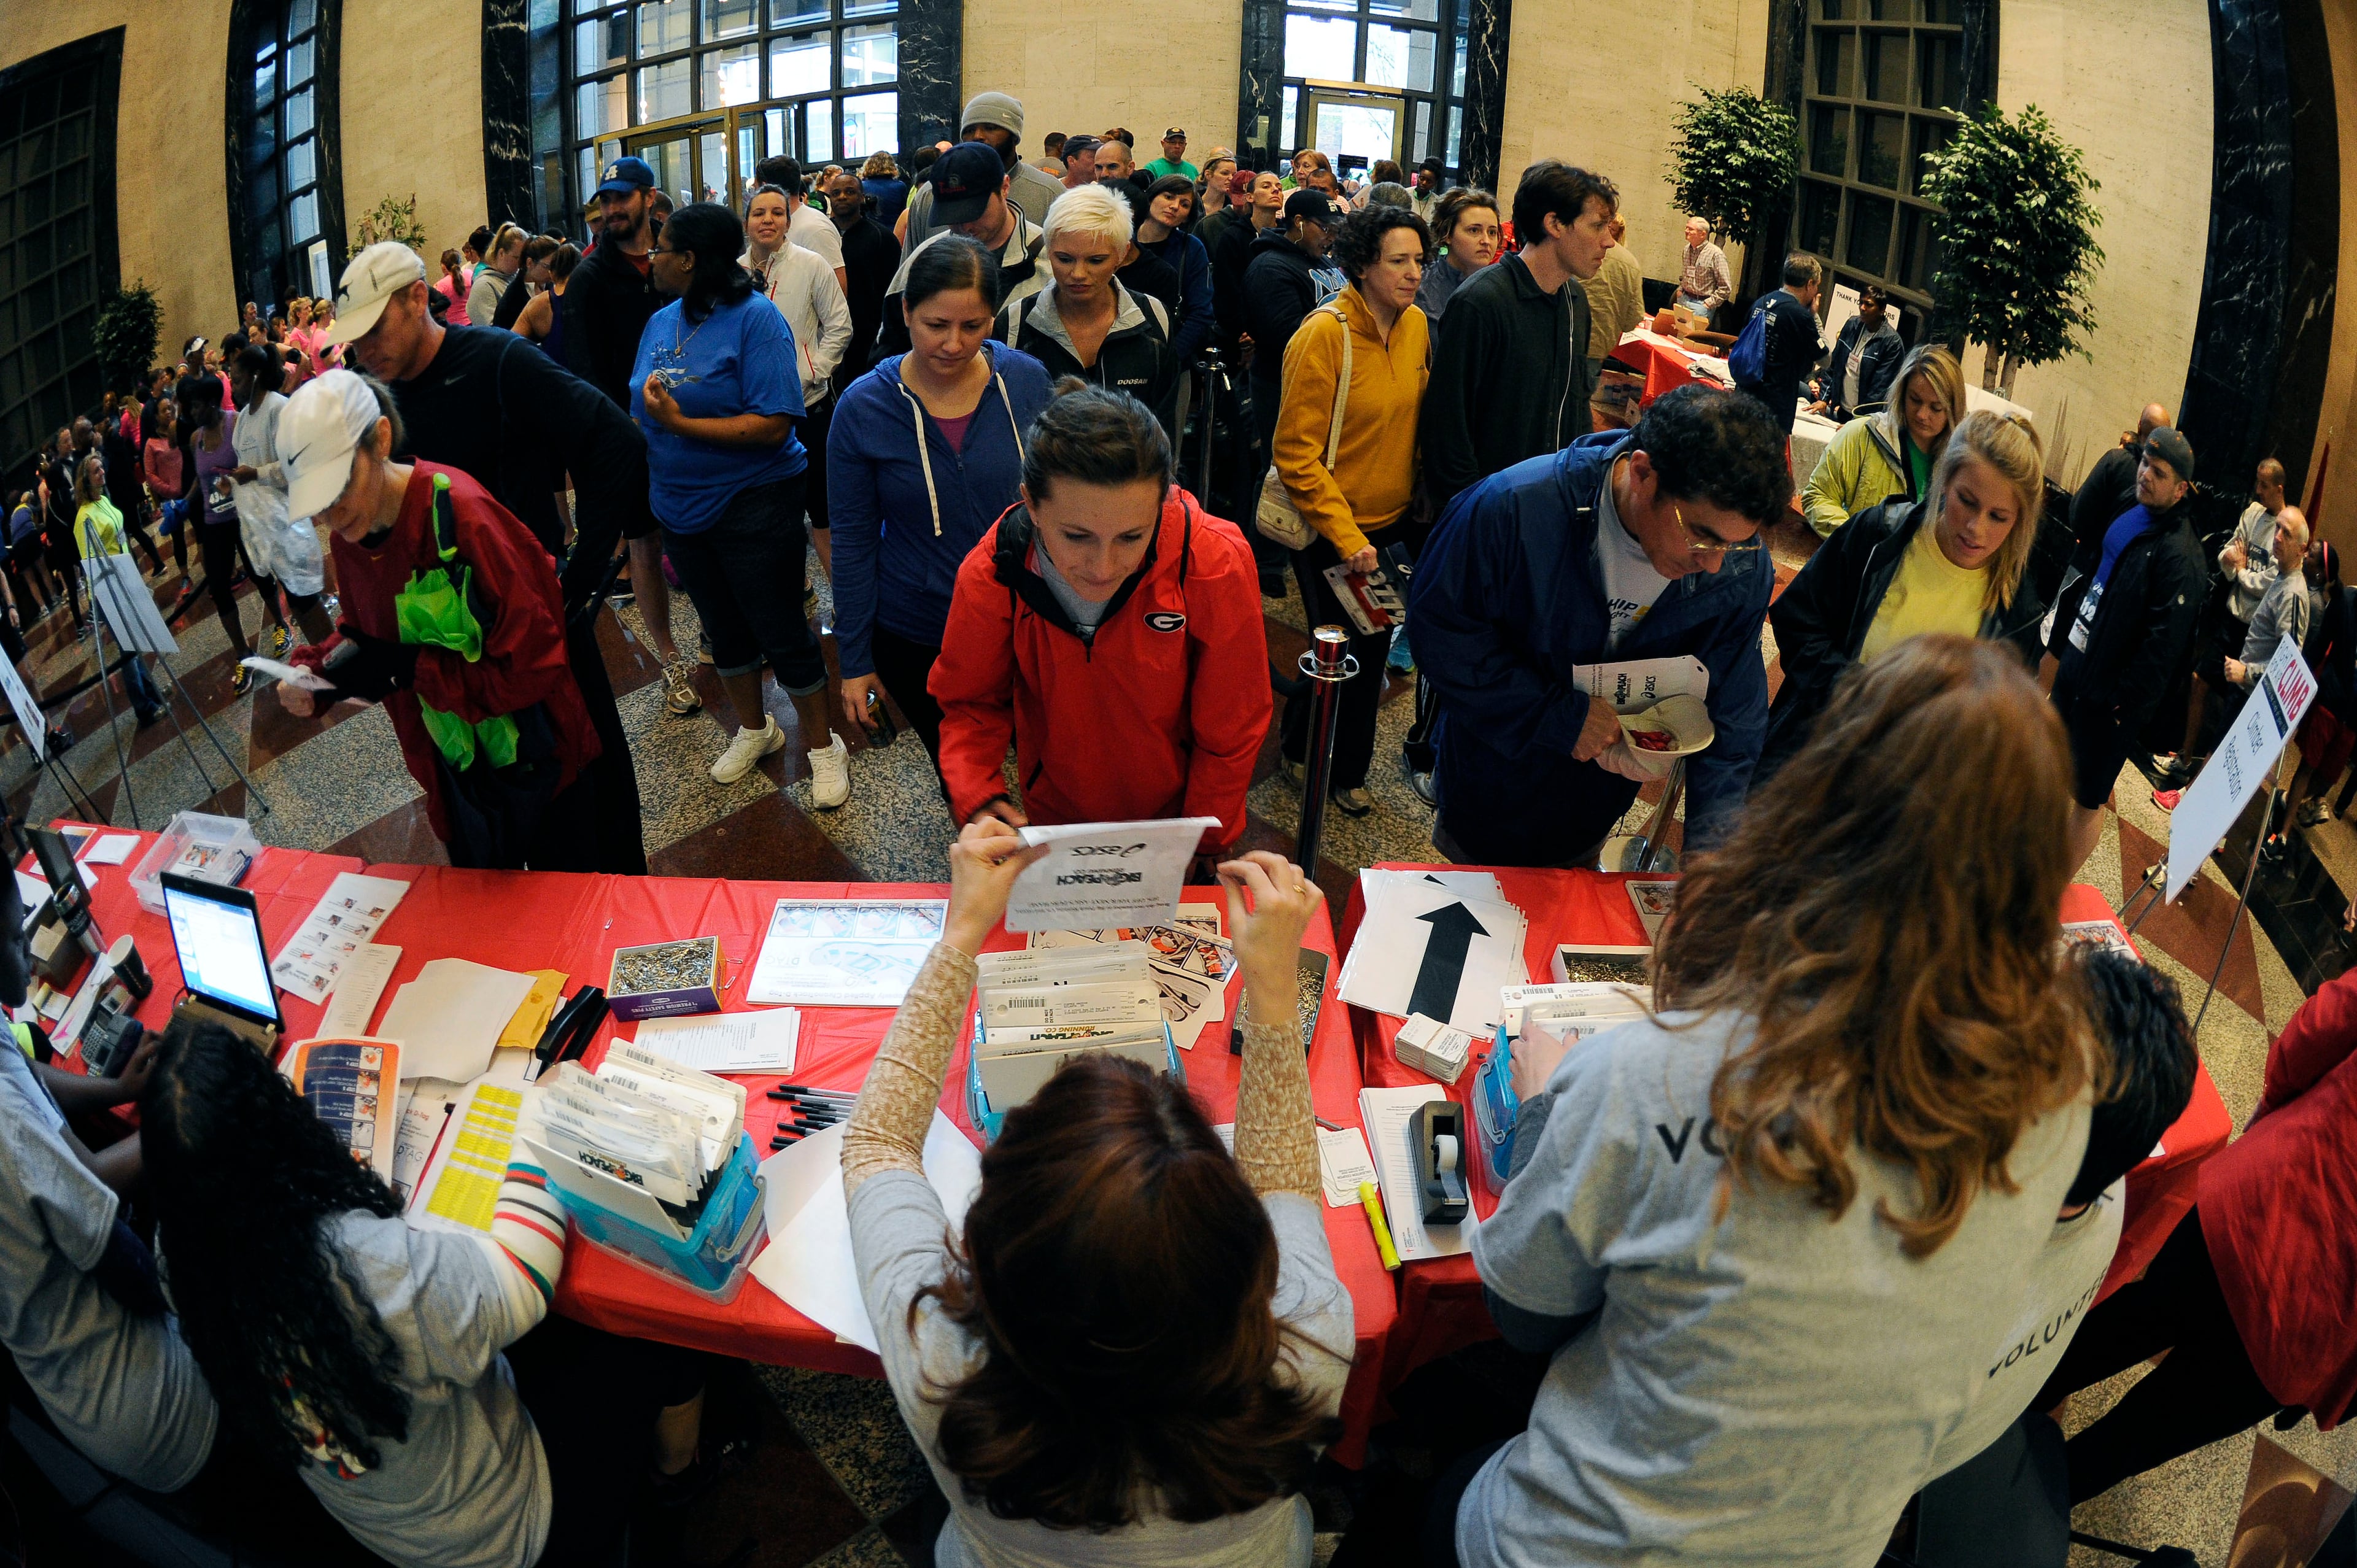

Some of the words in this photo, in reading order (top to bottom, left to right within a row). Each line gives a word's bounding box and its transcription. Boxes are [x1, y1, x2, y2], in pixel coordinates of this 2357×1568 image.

[1836, 292, 1852, 302] THANK
[1608, 599, 1638, 611] HIP
[1611, 611, 1631, 619] GHT
[1617, 673, 1627, 690] PEACH
[2278, 660, 2309, 722] CLIMB
[1617, 695, 1625, 705] BIG
[2247, 711, 2264, 756] Climber
[2223, 735, 2242, 803] Registration
[1056, 873, 1101, 886] PEACH
[414, 1110, 430, 1121] D-Tag
[397, 1145, 424, 1162] DTAG
[579, 1151, 615, 1173] PEACH
[1987, 1267, 2108, 1379] VOLUNTEE
